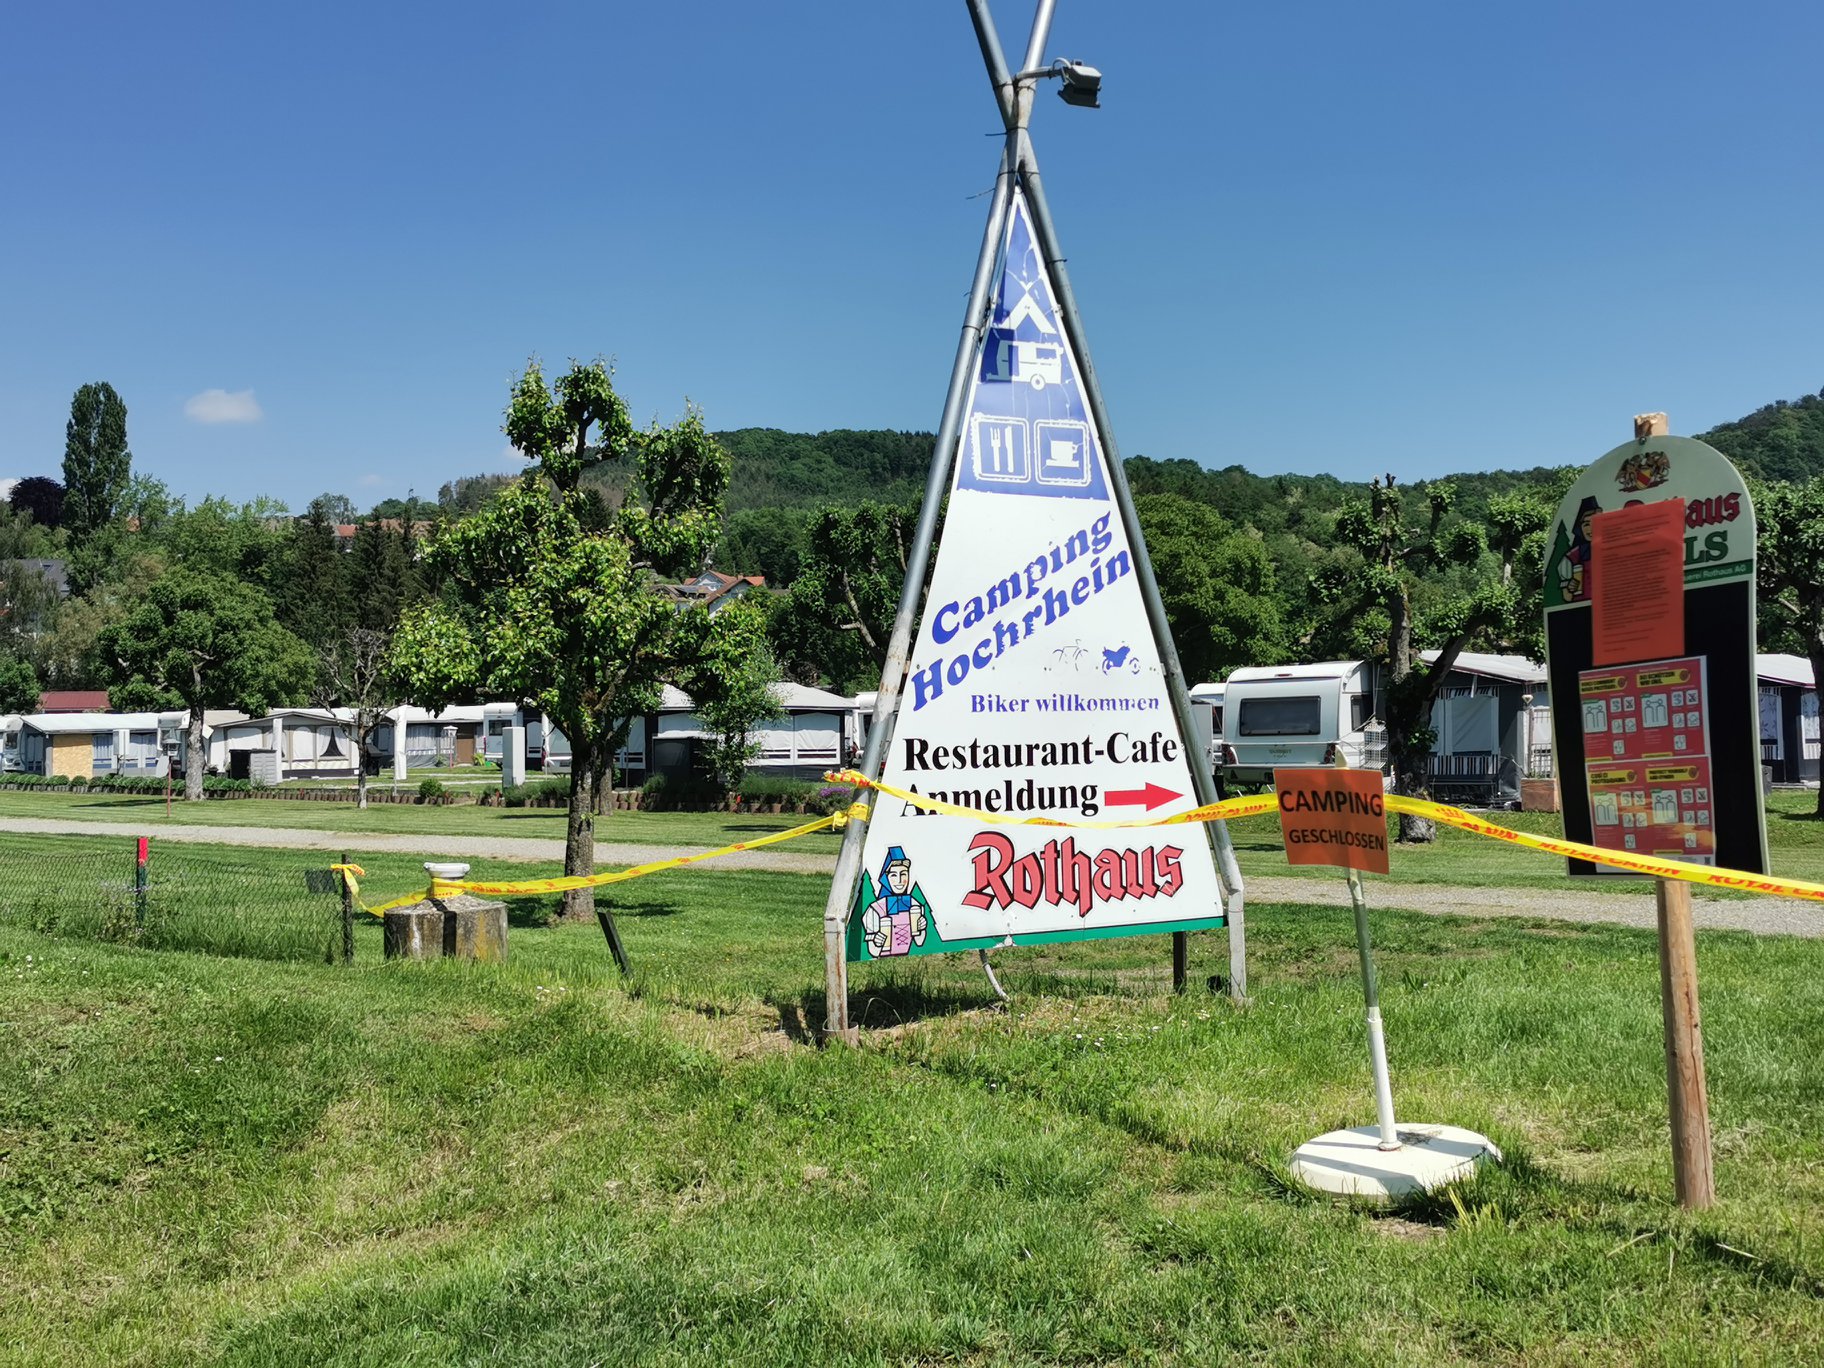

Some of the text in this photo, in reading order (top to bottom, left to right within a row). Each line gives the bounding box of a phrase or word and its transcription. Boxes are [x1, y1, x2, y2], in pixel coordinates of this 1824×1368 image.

[1683, 530, 1729, 566] LS
[931, 511, 1112, 645] Camping
[911, 550, 1131, 712] Hochrhein
[971, 693, 1160, 713] Biker willkommen
[903, 731, 1178, 771] Restaurant-Cafe
[1279, 789, 1383, 817] CAMPING
[1288, 829, 1384, 850] GESCHLOSSEN
[961, 831, 1184, 918] Rothaus
